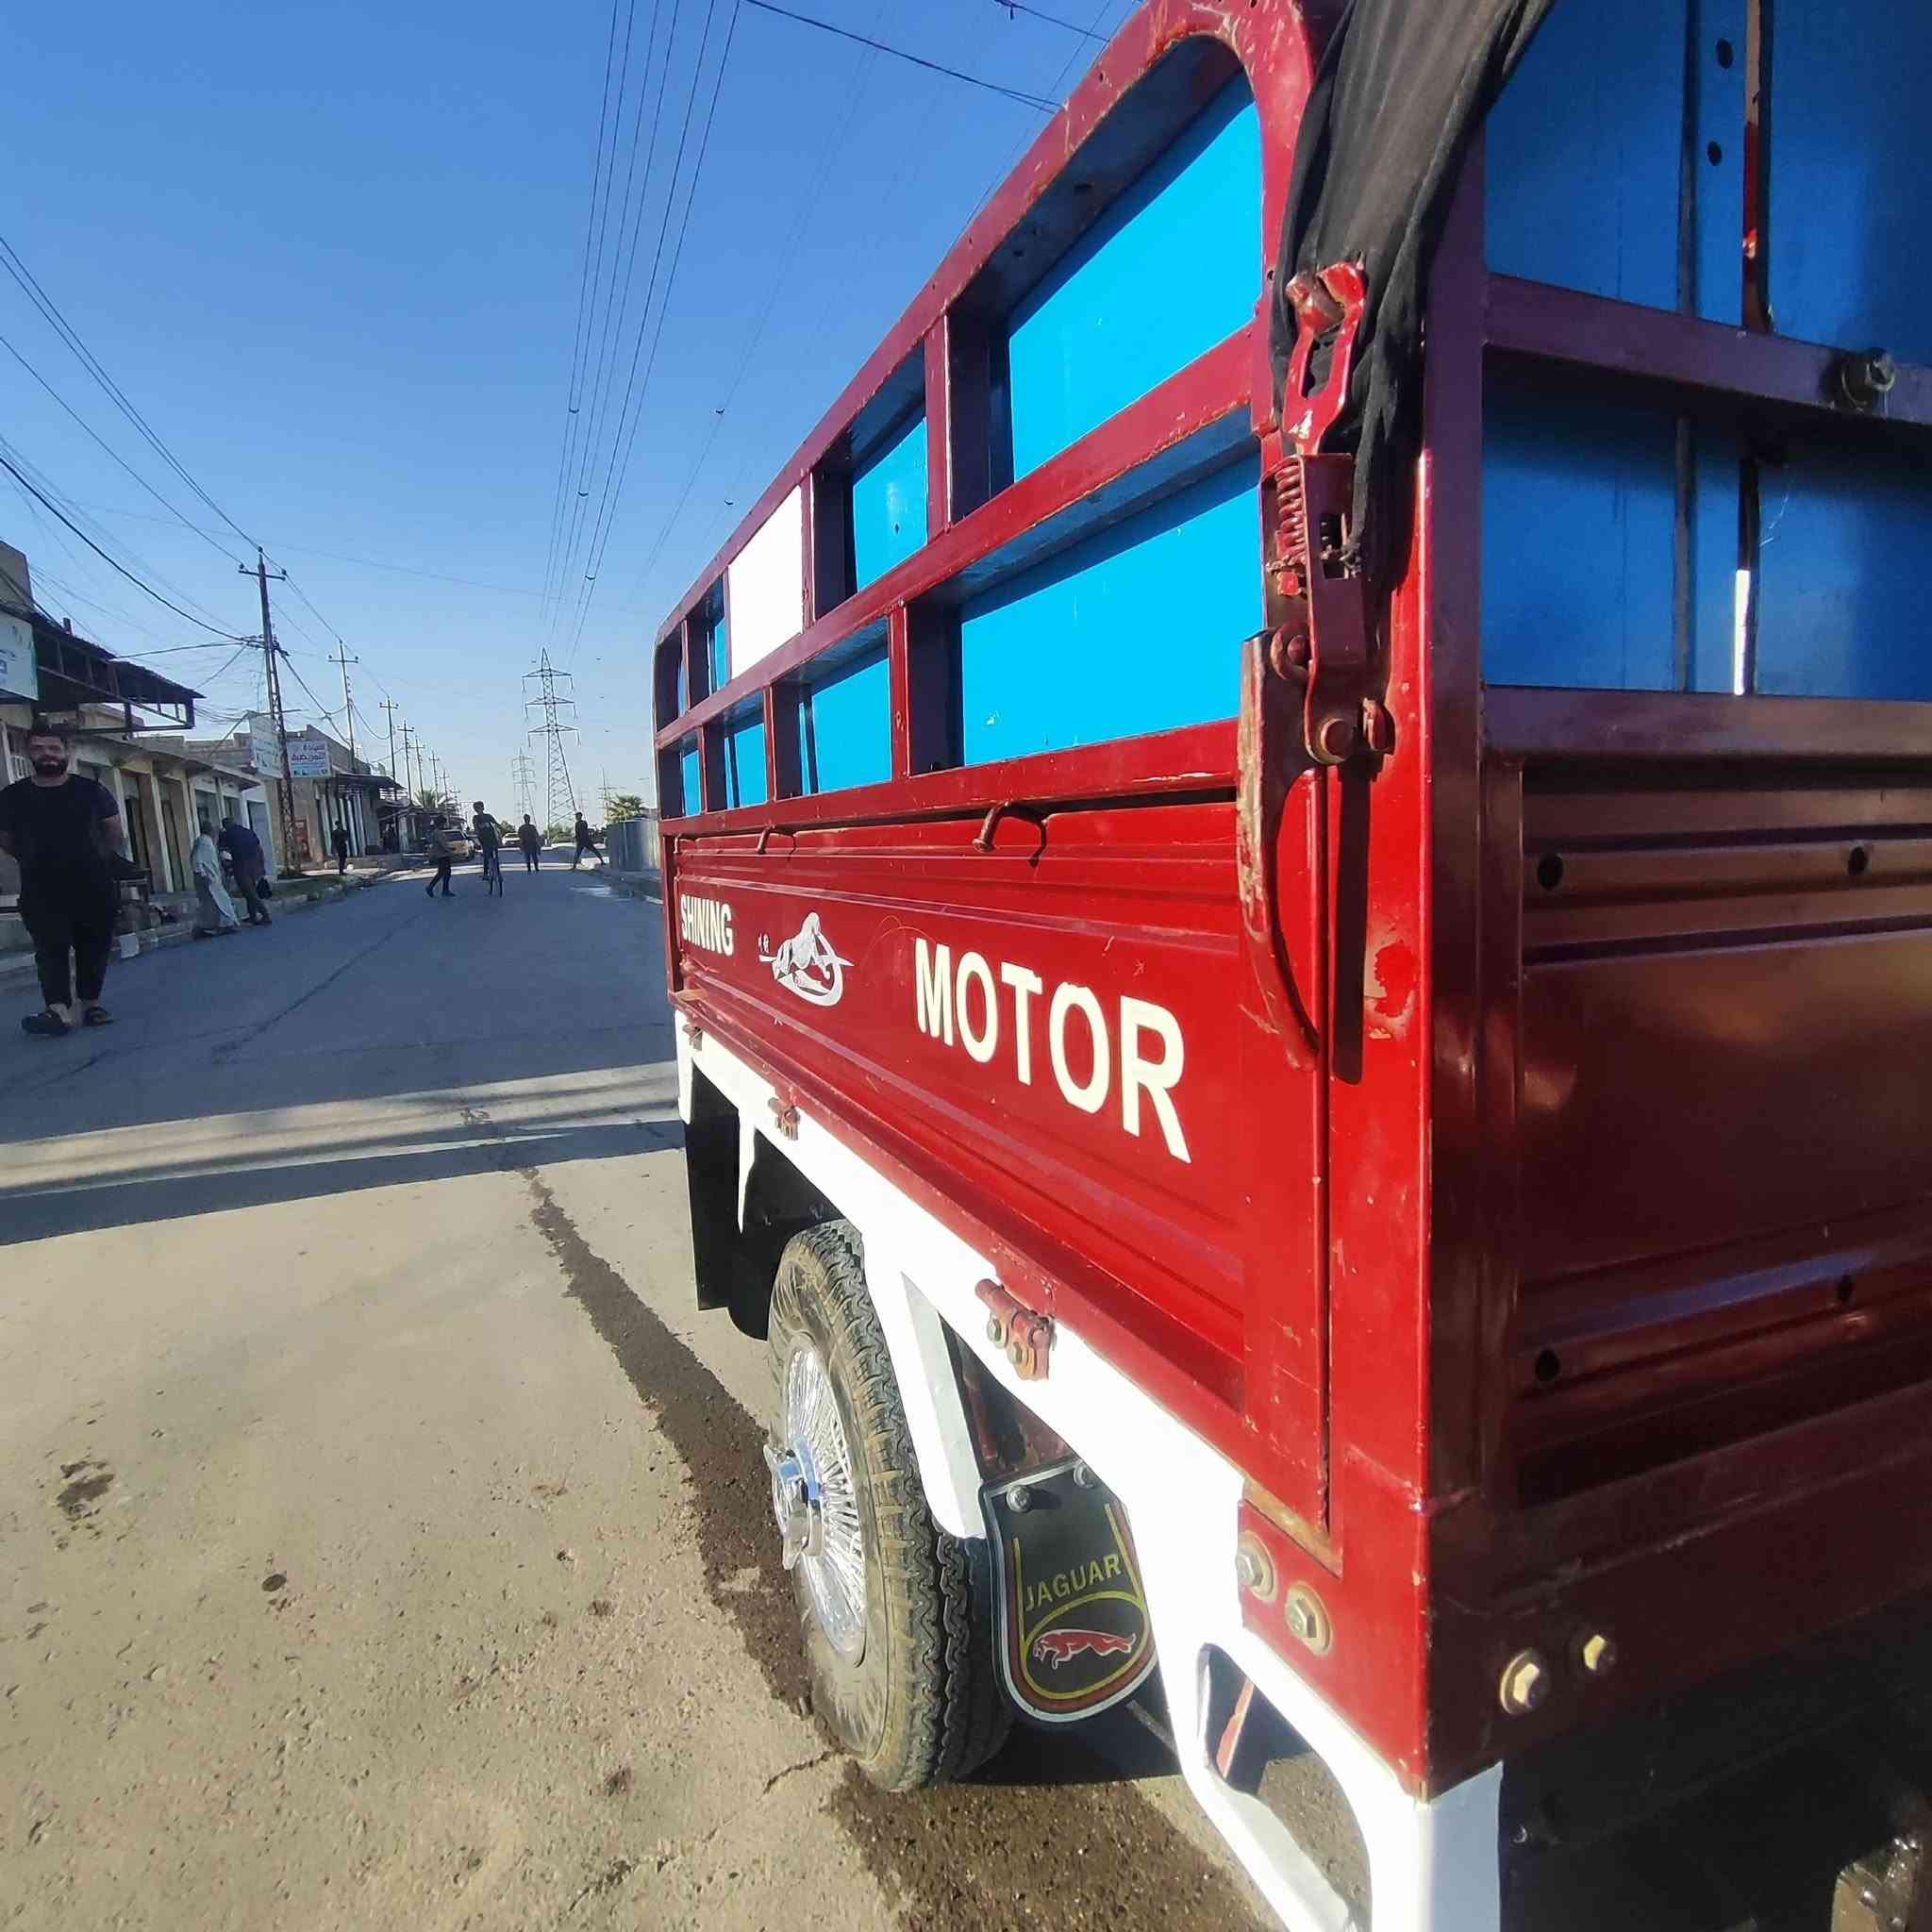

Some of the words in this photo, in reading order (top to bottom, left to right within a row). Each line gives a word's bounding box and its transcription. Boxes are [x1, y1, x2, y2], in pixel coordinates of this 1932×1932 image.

[680, 893, 734, 956] SHINING
[914, 937, 1191, 1163] MOTOR
[1025, 1554, 1122, 1611] JAGUAR
